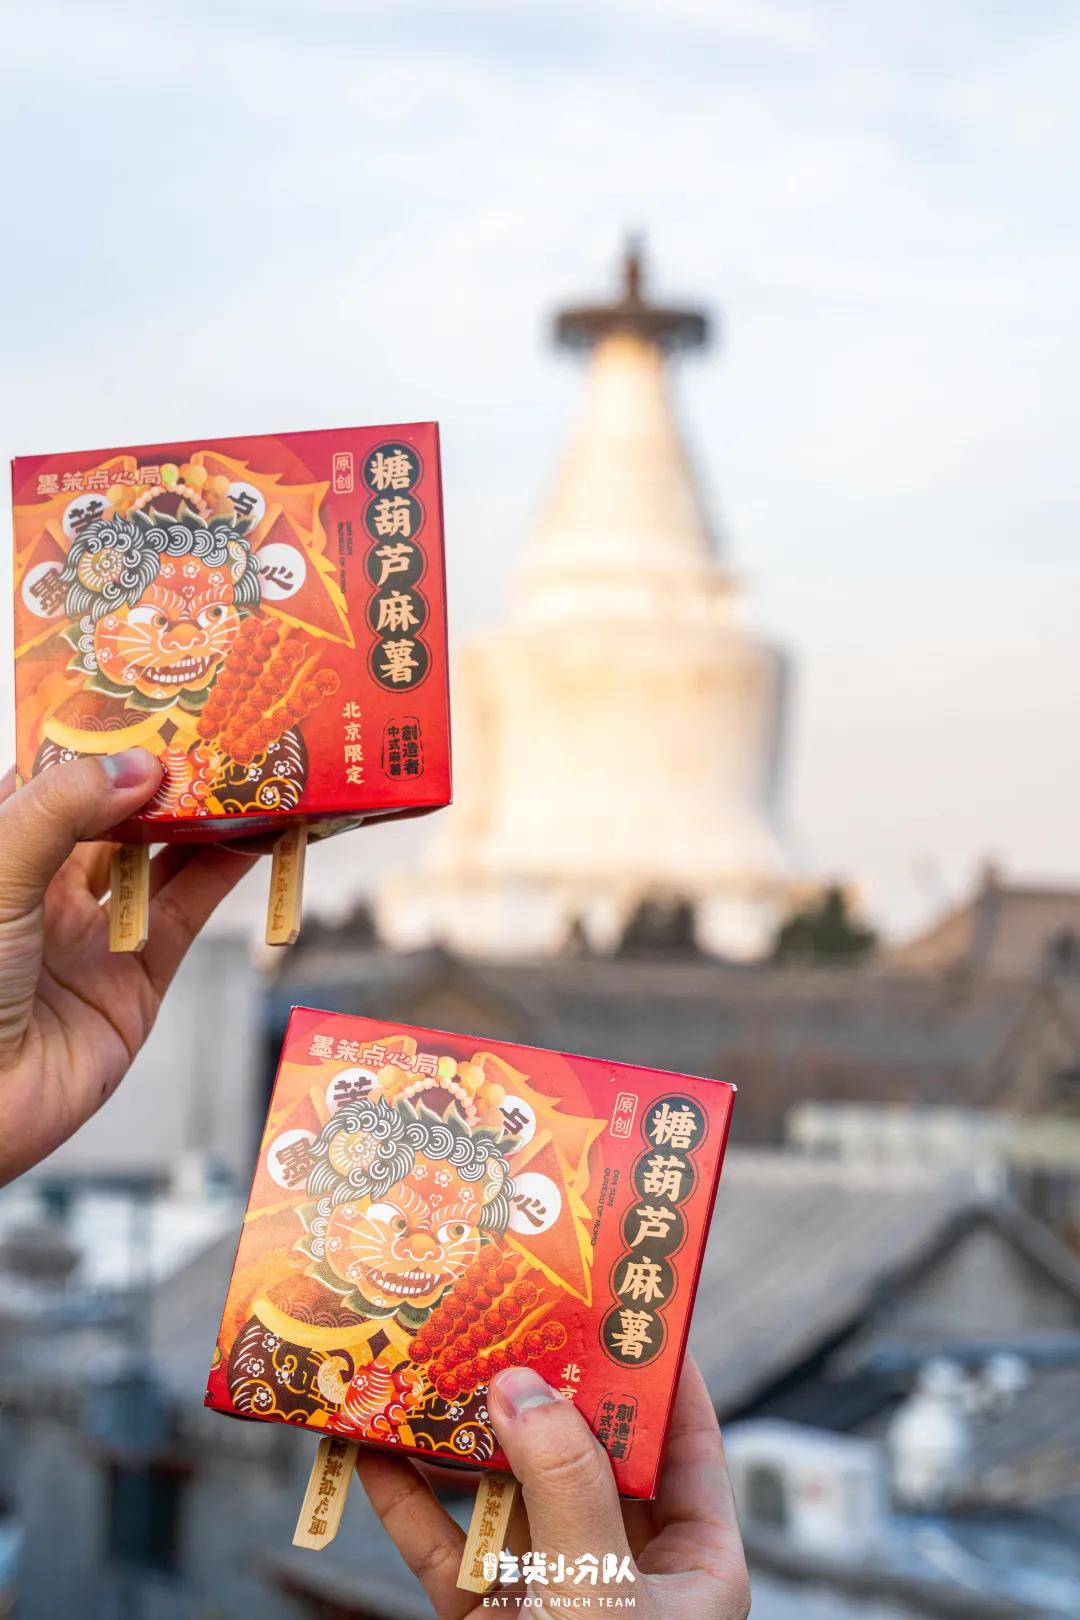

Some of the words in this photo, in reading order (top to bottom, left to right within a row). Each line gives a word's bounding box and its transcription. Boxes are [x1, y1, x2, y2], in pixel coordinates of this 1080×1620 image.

[36, 465, 162, 495] 墨茉点心局
[335, 455, 352, 490] 原创
[260, 565, 294, 591] 心
[369, 450, 420, 684] 糖葫芦麻薯
[342, 701, 365, 785] 北京限定
[308, 1034, 440, 1077] 墨茉点心局
[613, 1096, 636, 1135] 原创
[512, 1194, 547, 1228] 心
[609, 1102, 698, 1359] 糖葫芦麻薯
